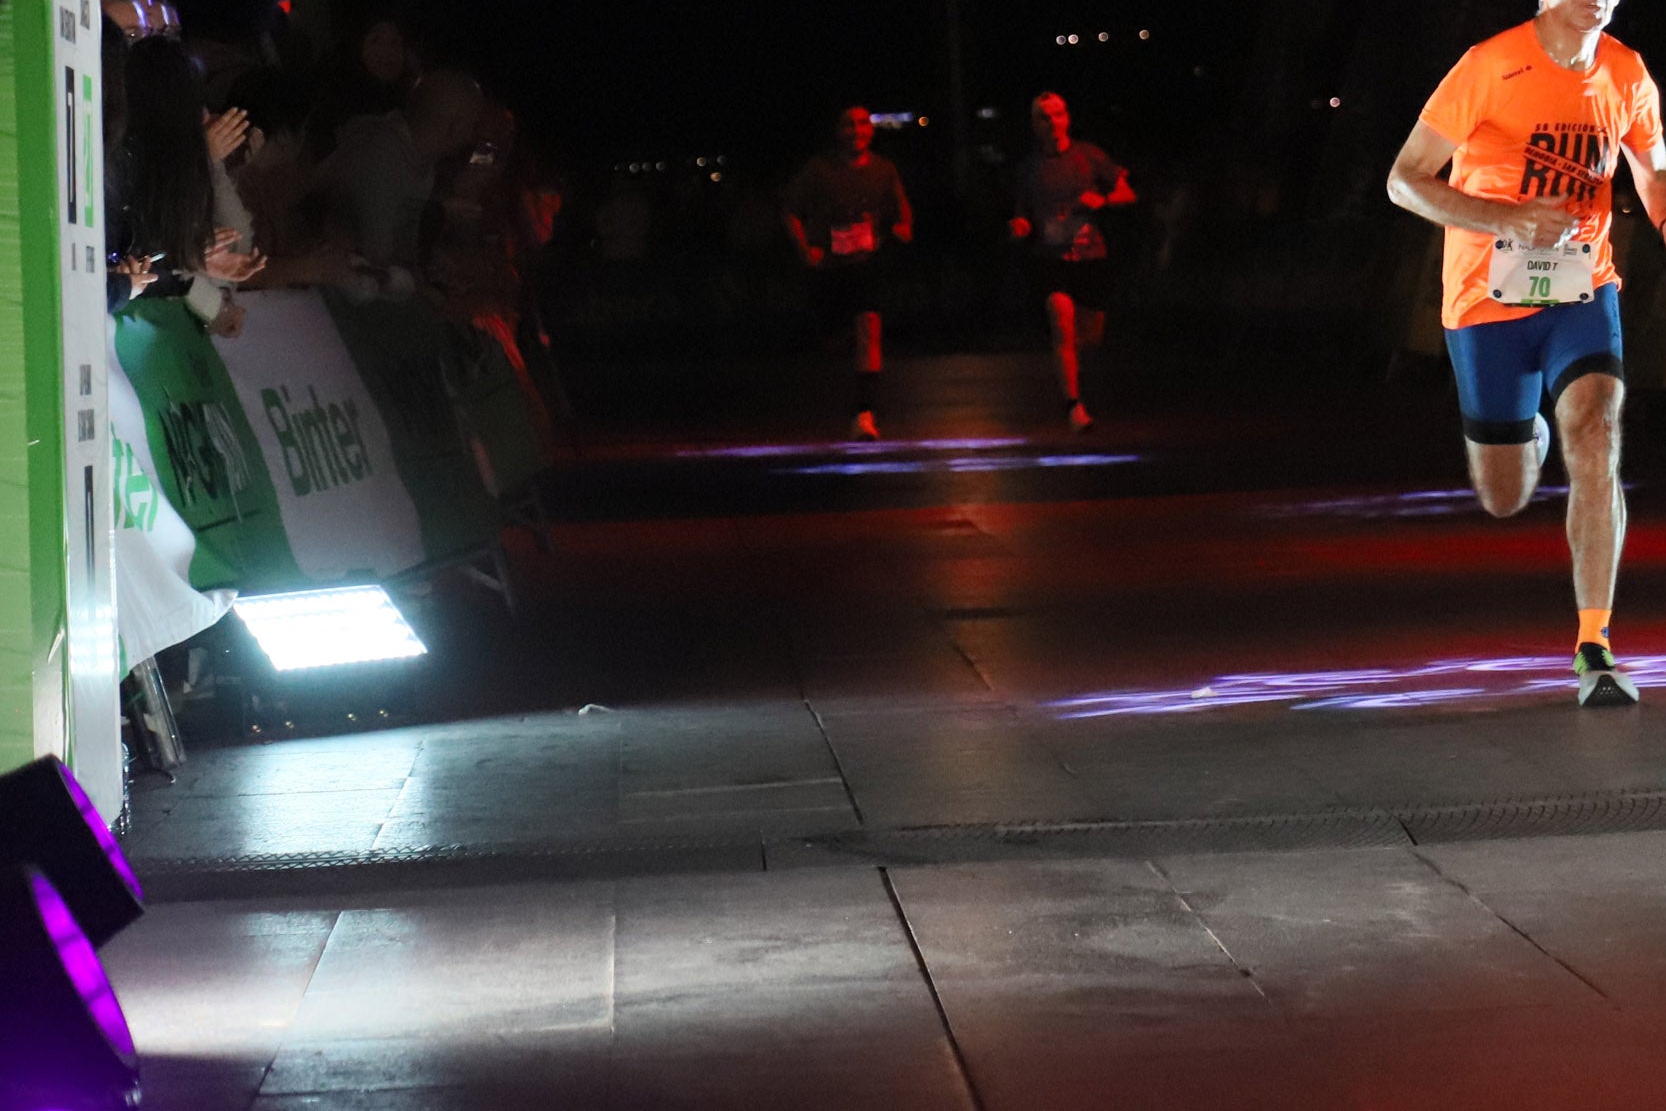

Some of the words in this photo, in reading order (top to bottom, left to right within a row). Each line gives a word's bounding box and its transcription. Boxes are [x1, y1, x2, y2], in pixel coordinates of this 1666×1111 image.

[1527, 260, 1551, 271] DAVID
[1552, 261, 1559, 272] T
[1529, 276, 1551, 298] 70
[260, 384, 375, 498] Binter
